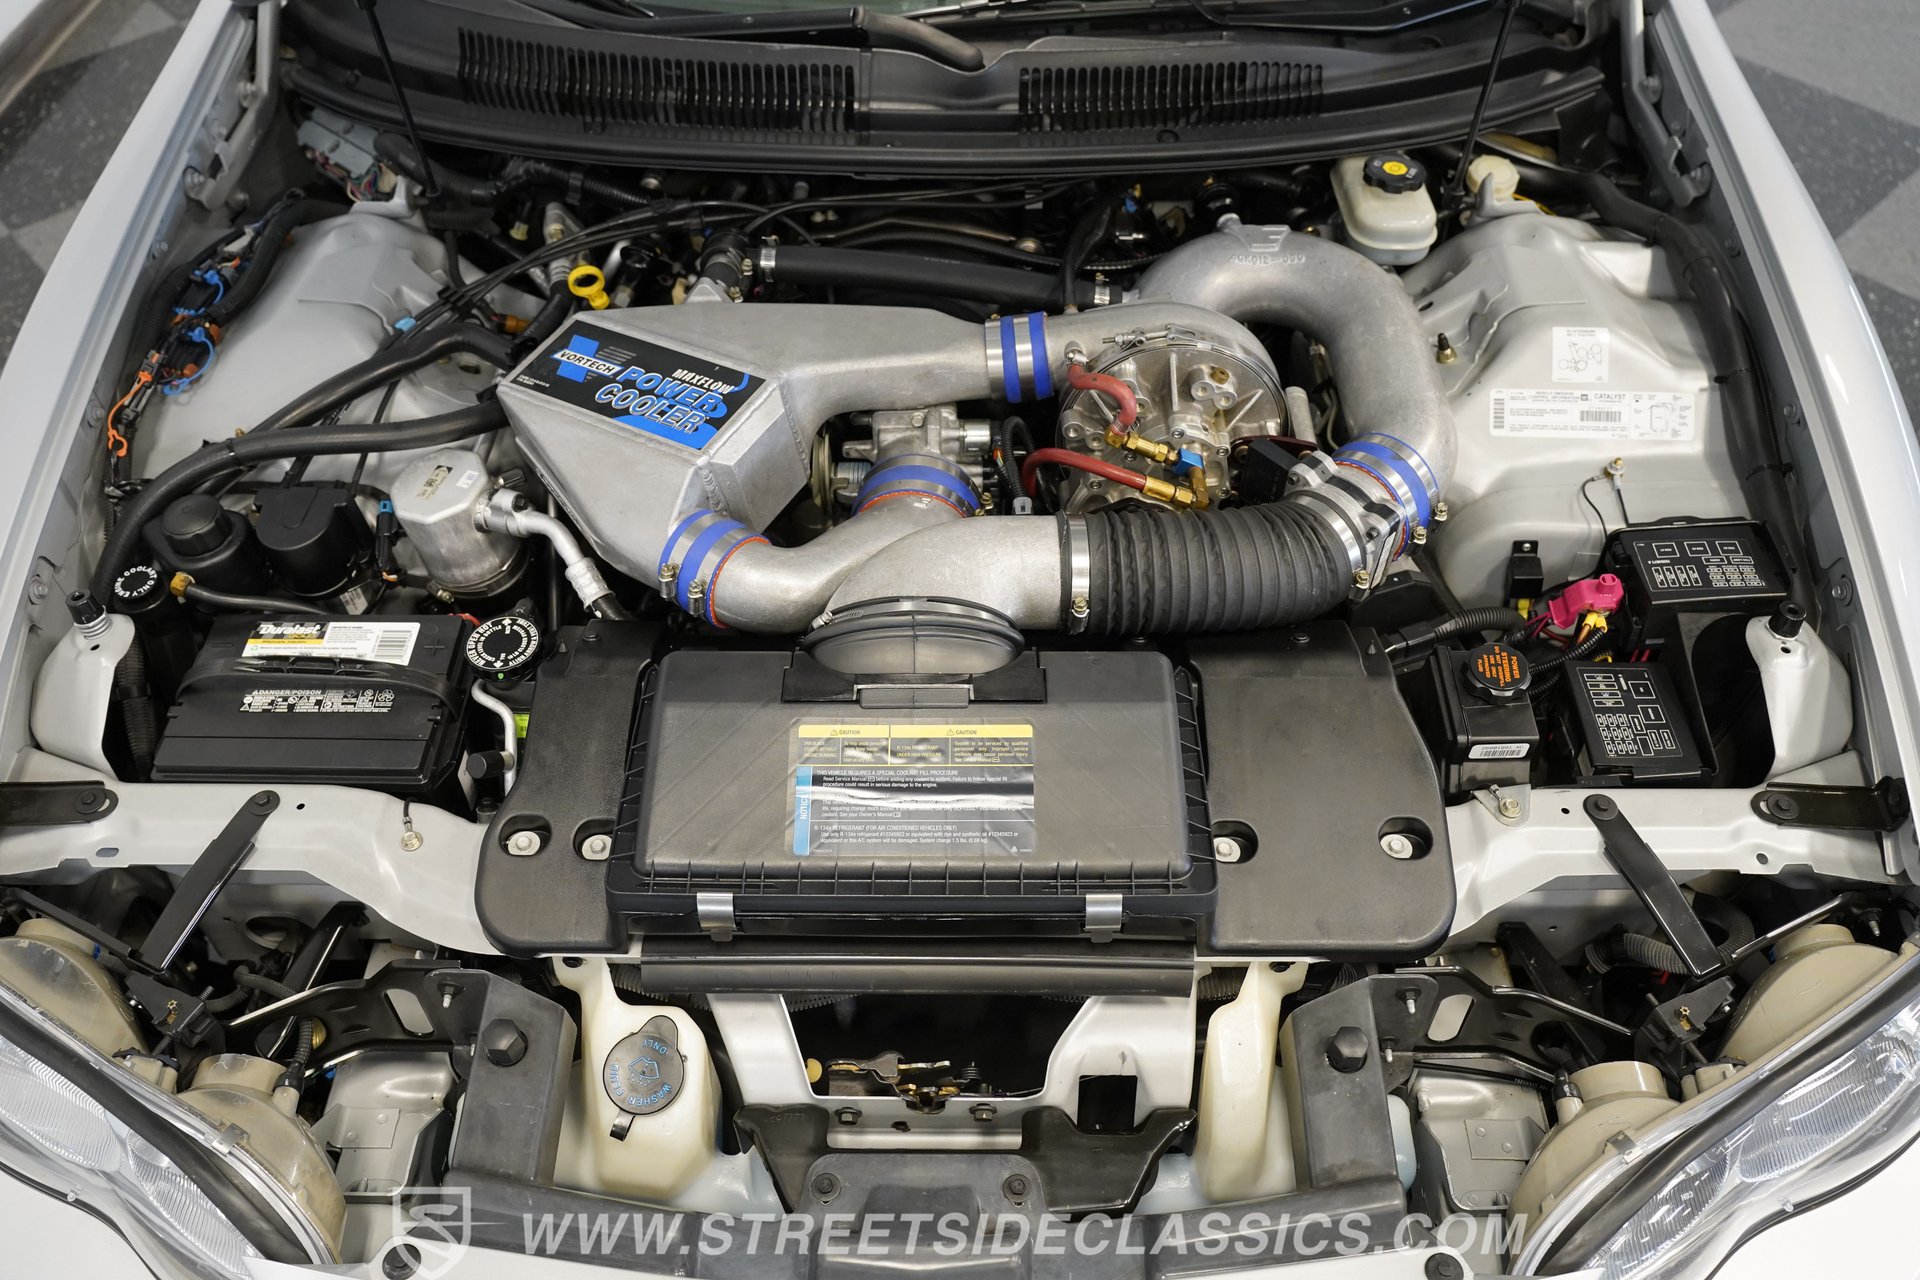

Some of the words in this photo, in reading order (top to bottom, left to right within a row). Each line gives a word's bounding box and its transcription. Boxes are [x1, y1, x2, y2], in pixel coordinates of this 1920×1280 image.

[560, 350, 615, 374] VORTECH
[616, 366, 725, 412] POWER
[672, 369, 735, 395] MAXFLOW
[595, 384, 708, 434] COOLER
[124, 566, 157, 578] COOLANT
[114, 577, 130, 597] ENGINE
[132, 580, 155, 596] ONLY
[259, 624, 321, 634] Duralast
[477, 621, 492, 633] HOT
[468, 633, 480, 648] OPEN
[468, 650, 486, 666] NEVER
[1483, 655, 1491, 678] APPROVED
[1501, 652, 1511, 682] STEERING
[1511, 656, 1520, 679] POWER
[643, 1039, 668, 1054] ONLY
[610, 1064, 624, 1096] FLUID
[627, 1082, 671, 1106] WASHER
